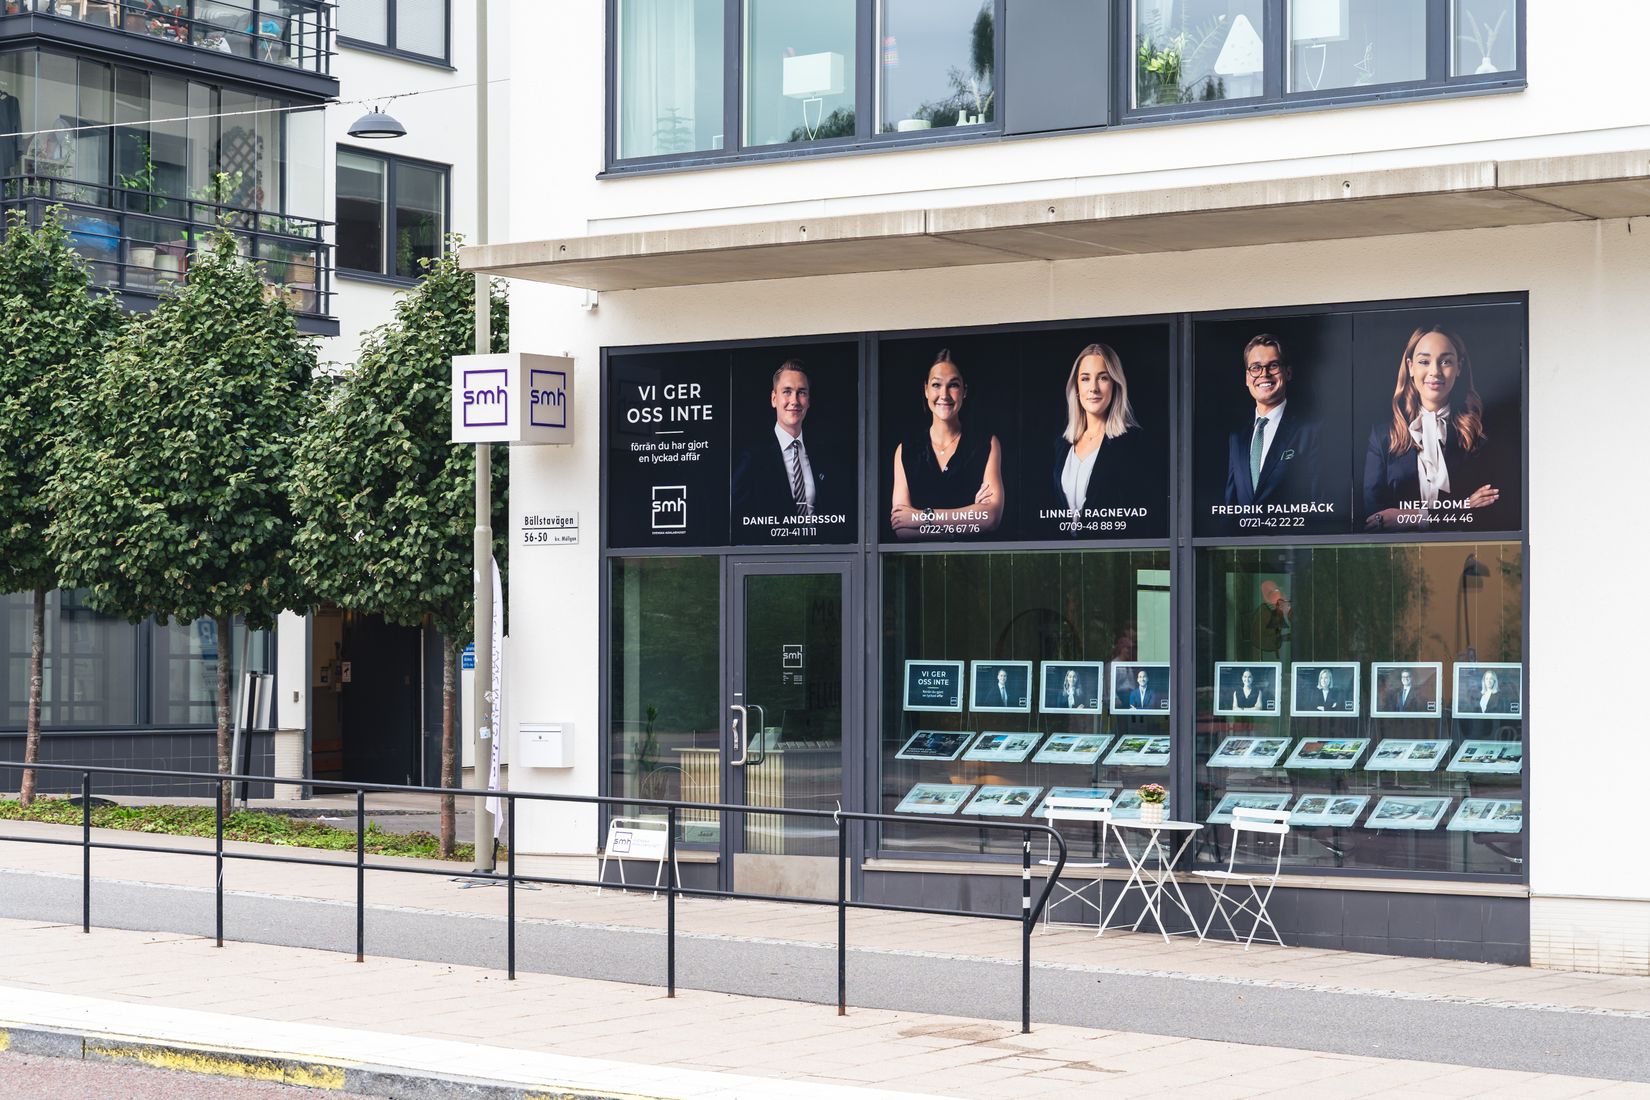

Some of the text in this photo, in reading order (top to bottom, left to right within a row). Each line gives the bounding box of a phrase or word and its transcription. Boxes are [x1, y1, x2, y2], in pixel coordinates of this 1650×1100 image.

[638, 383, 701, 401] VI GER
[626, 405, 713, 423] OSS INTE
[630, 440, 709, 451] förrän du har gjort
[638, 452, 701, 464] en lyckad affär
[1211, 502, 1334, 515] FREDRIK PALMBÄCK
[1399, 497, 1471, 510] INEZ DOMÉ
[911, 509, 989, 521] NOOMI UNÉUS
[1039, 507, 1148, 519] LINNEA RAGNEVAD
[1397, 513, 1474, 524] 0707-44 44 46
[524, 515, 574, 528] Bällstavägen
[742, 514, 846, 526] DANIEL ANDERSSON
[1059, 521, 1127, 531] 0709-48 88 99
[1239, 517, 1305, 528] 0721-42 22 22
[770, 527, 817, 537] 0721-41 11 11
[919, 524, 980, 534] 0722-76 67 76
[524, 532, 548, 543] 56-50
